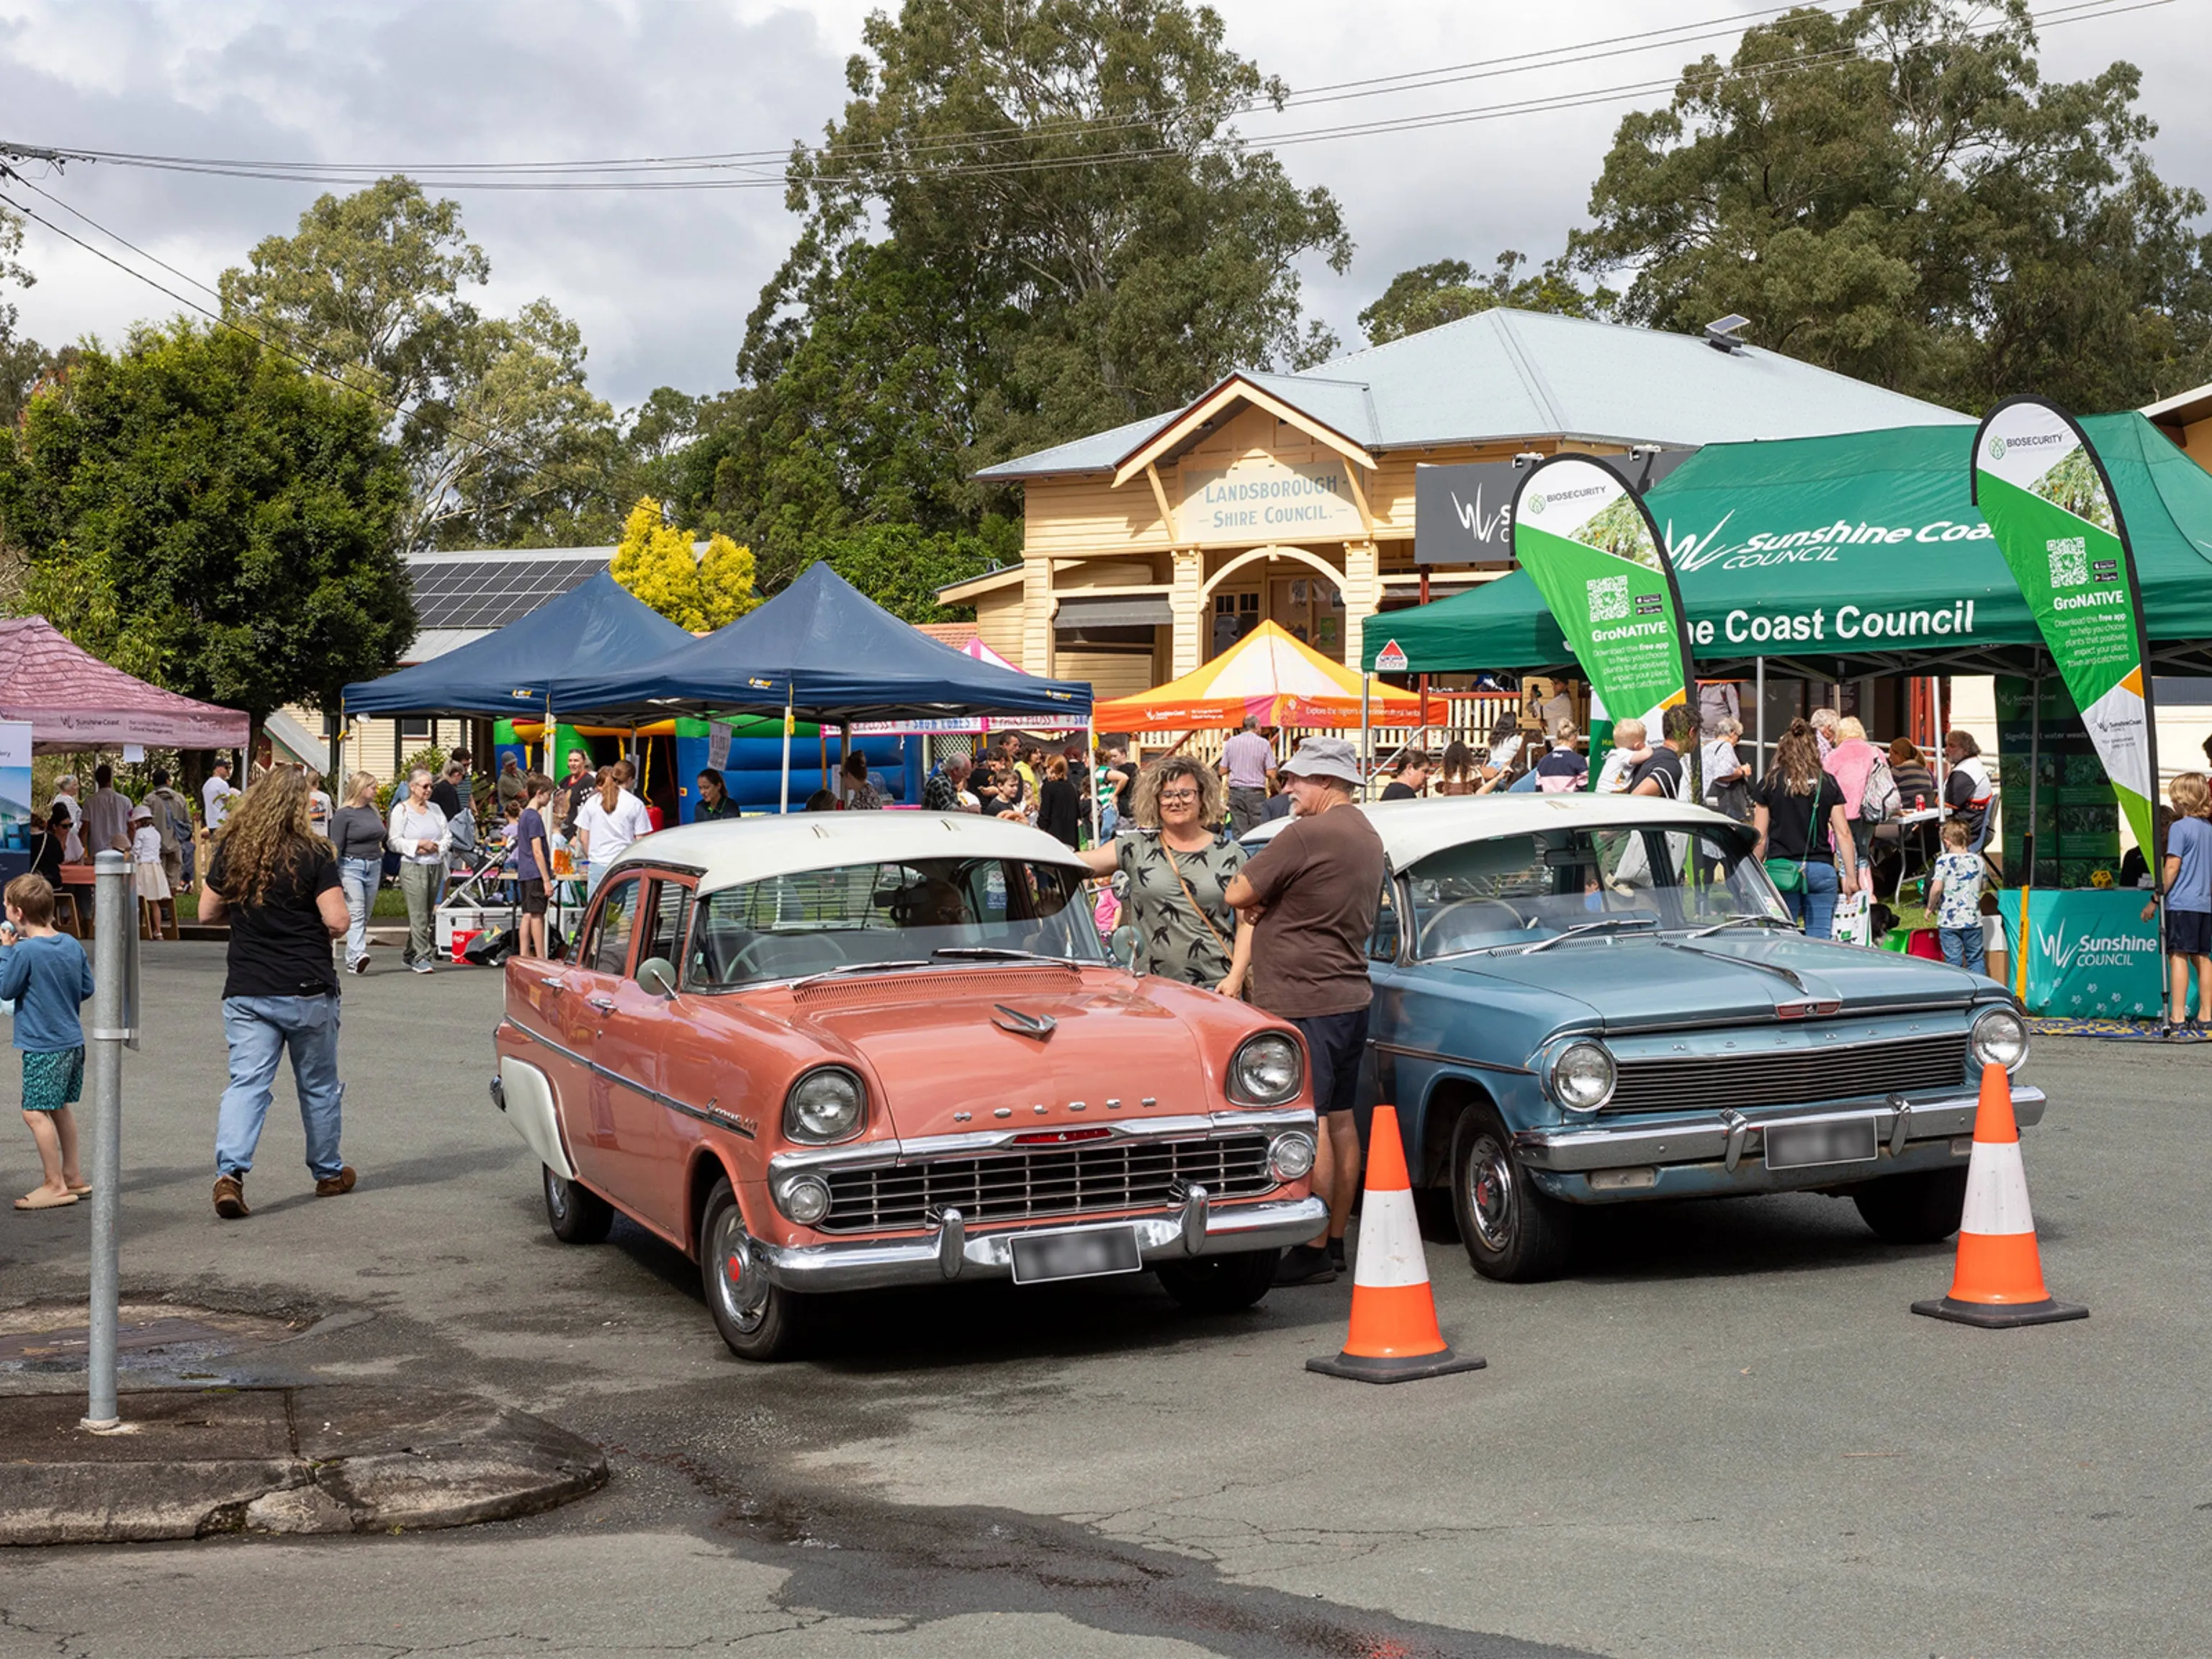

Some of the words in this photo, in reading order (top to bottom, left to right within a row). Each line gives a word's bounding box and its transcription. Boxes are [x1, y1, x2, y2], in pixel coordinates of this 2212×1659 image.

[2006, 433, 2063, 447] BIOSECURITY
[1205, 475, 1338, 504] LANDSBOROUGH
[1547, 485, 1606, 503] BIOSECURITY
[1213, 510, 1258, 529] SHIRE
[1737, 519, 1912, 554] Sunshine
[1915, 521, 1995, 543] Coa
[1722, 546, 1840, 570] COUNCIL
[2054, 590, 2124, 611] GroNATIVE
[1725, 607, 1825, 643] Coast
[1835, 599, 1974, 638] Council
[2077, 626, 2092, 634] help
[2105, 623, 2127, 631] choose
[1592, 621, 1668, 642] GroNATIVE
[2100, 633, 2128, 644] positively
[1645, 651, 1670, 660] choose
[1639, 660, 1670, 670] positively
[2004, 732, 2044, 742] Significat
[2079, 934, 2158, 952] Sunshine
[2077, 953, 2134, 968] COUNCIL
[1671, 1023, 1920, 1051] HOLDEN
[954, 1097, 1157, 1122] HOLDEN
